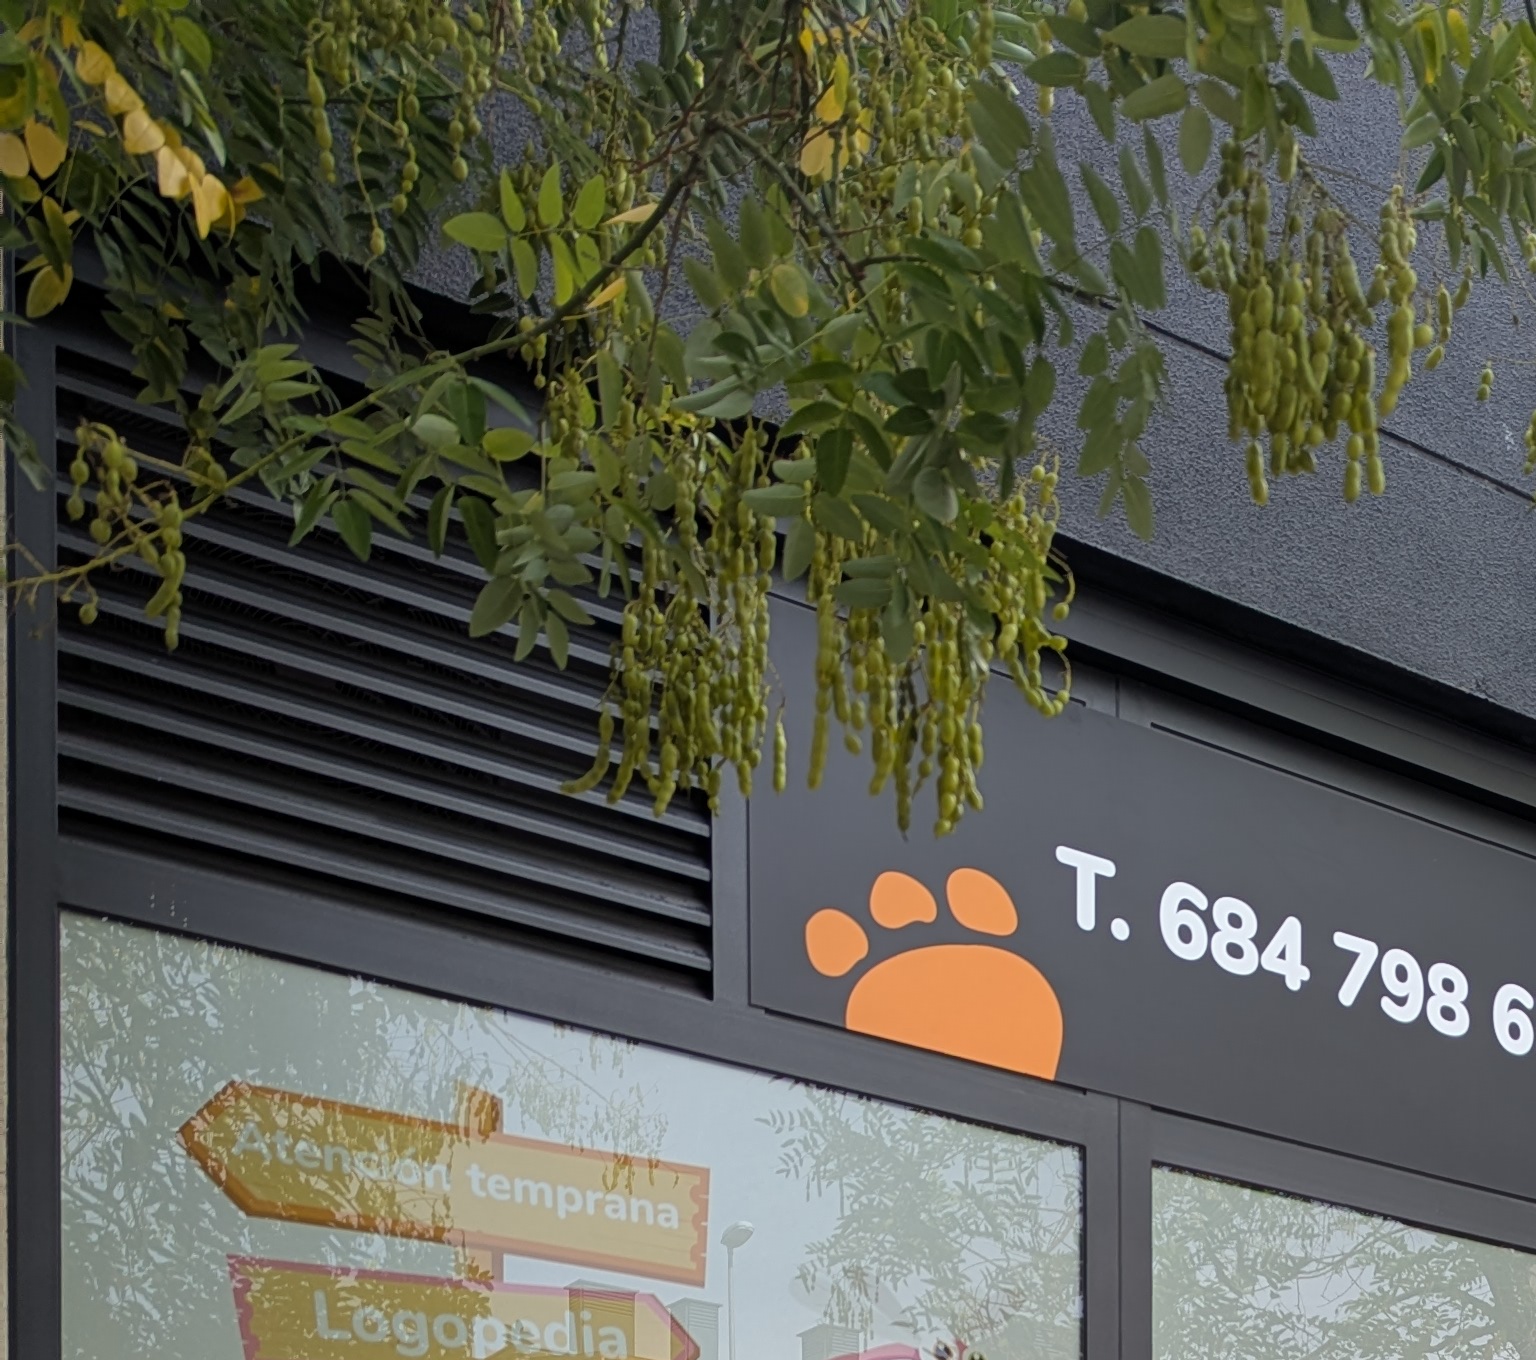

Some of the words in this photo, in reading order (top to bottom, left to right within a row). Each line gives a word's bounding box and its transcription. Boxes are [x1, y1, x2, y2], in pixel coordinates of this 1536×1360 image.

[1055, 845, 1131, 942] T.
[1159, 881, 1311, 991] 684
[1332, 931, 1471, 1038] 798
[232, 1120, 451, 1191] Atención
[466, 1161, 680, 1231] temprana
[312, 1289, 629, 1360] Logopedia
